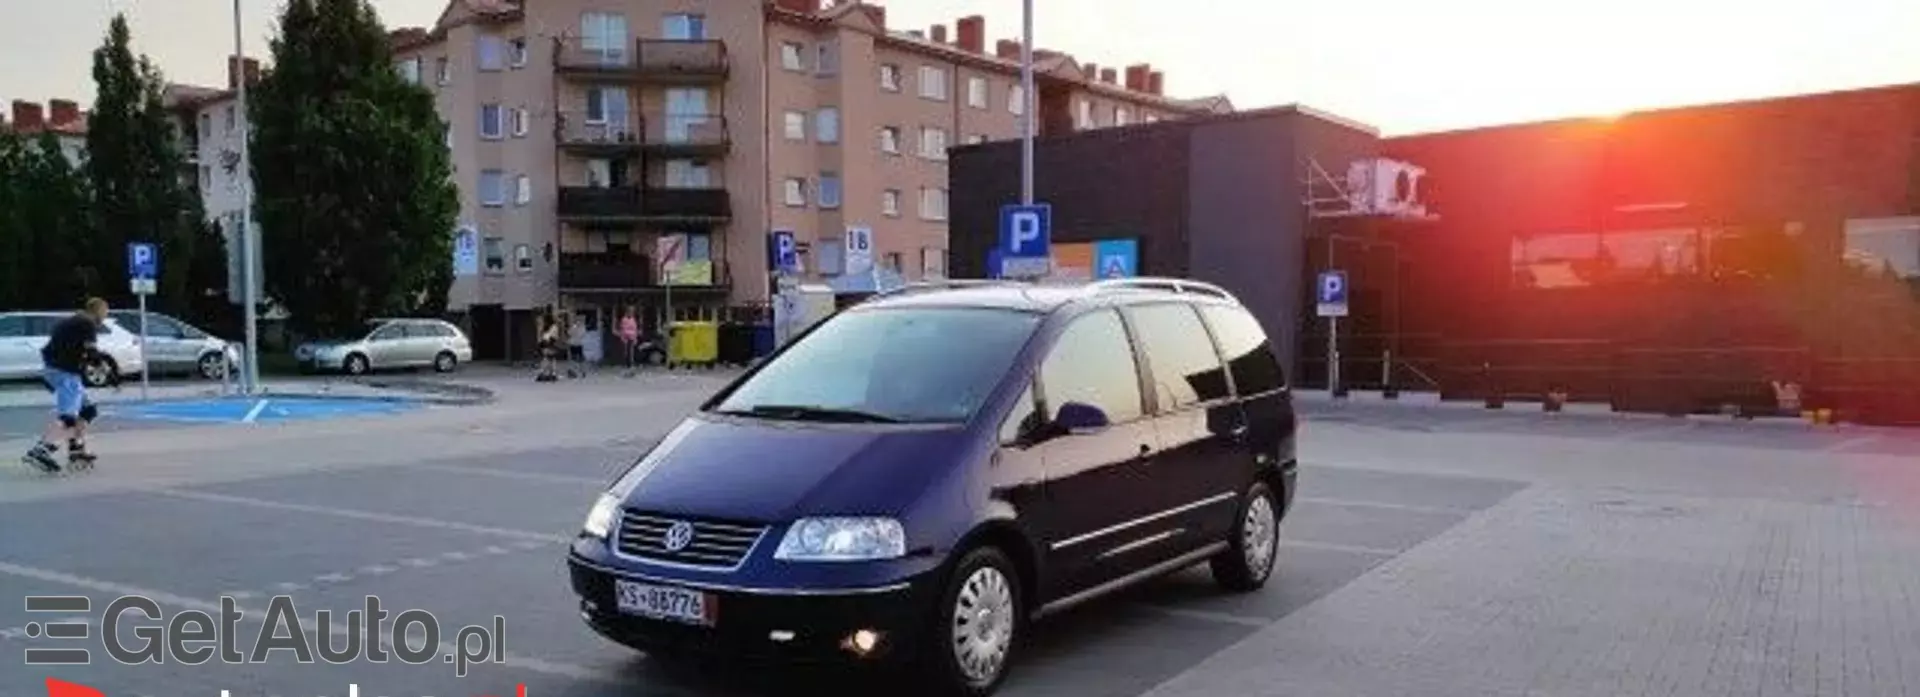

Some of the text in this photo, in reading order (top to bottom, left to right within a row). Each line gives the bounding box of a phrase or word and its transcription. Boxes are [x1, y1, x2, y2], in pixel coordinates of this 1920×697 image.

[1010, 212, 1039, 253] P
[135, 245, 151, 265] P
[780, 233, 794, 261] P
[1324, 276, 1342, 300] P
